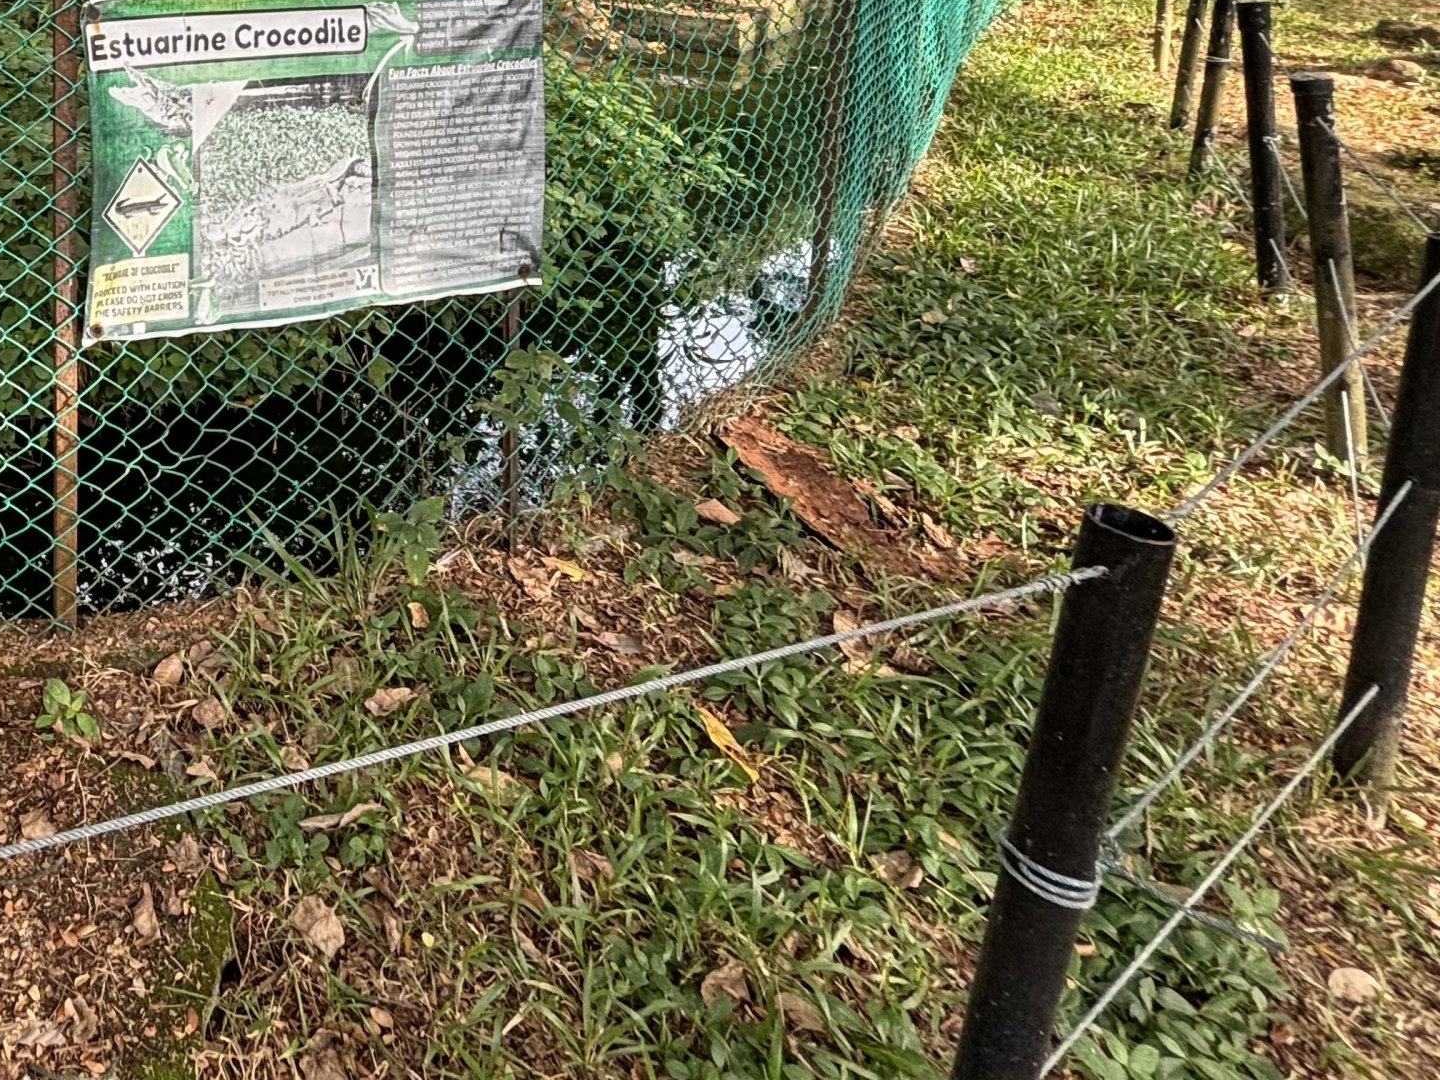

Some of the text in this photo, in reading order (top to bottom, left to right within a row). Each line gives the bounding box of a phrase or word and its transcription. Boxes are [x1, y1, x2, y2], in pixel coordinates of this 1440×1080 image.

[90, 17, 361, 61] Estuarine Crocodile
[389, 59, 537, 80] Fun Facts About Estuarine Crocodiles
[94, 280, 186, 299] PROCEED WITH CAUTION
[96, 291, 183, 308] PLEASE DO NOT CROSS
[94, 309, 110, 318] THE
[111, 305, 143, 318] SAFETY
